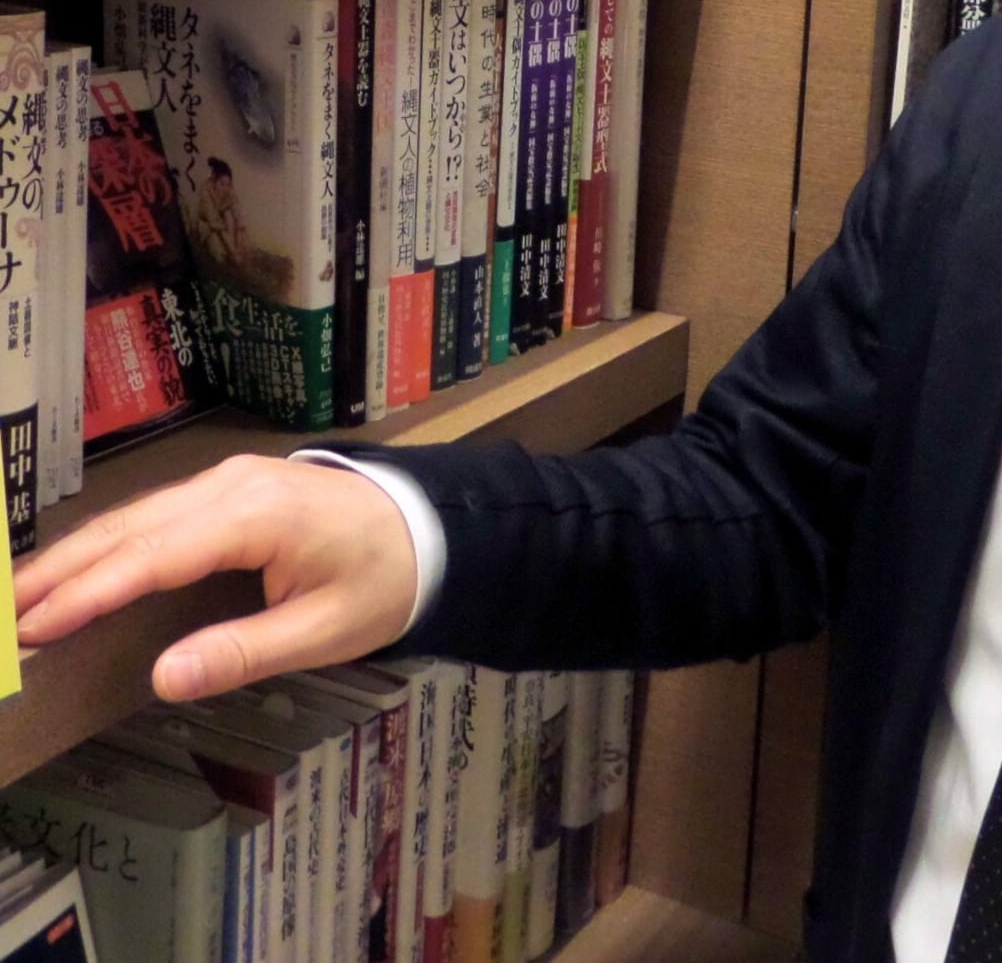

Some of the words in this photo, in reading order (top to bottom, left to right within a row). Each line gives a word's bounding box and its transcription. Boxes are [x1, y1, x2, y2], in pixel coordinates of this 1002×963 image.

[150, 3, 177, 112] 縄文人
[180, 6, 202, 192] タネをまく
[426, 0, 443, 158] 縄文土器ガイドブック
[55, 66, 70, 150] 縄文の思考
[75, 59, 89, 142] 縄文の思考
[320, 42, 337, 199] タネをまく縄文人
[593, 37, 615, 174] 縄文土器型式
[22, 92, 47, 221] 縄文の
[395, 88, 418, 268] 縄文人の植物利用
[474, 264, 485, 325] 山本直人
[520, 233, 533, 297] 田中清文
[539, 238, 552, 301] 田中清文
[555, 223, 568, 285] 田中清文
[161, 288, 192, 367] 東北の
[320, 313, 335, 373] 小畑弘己
